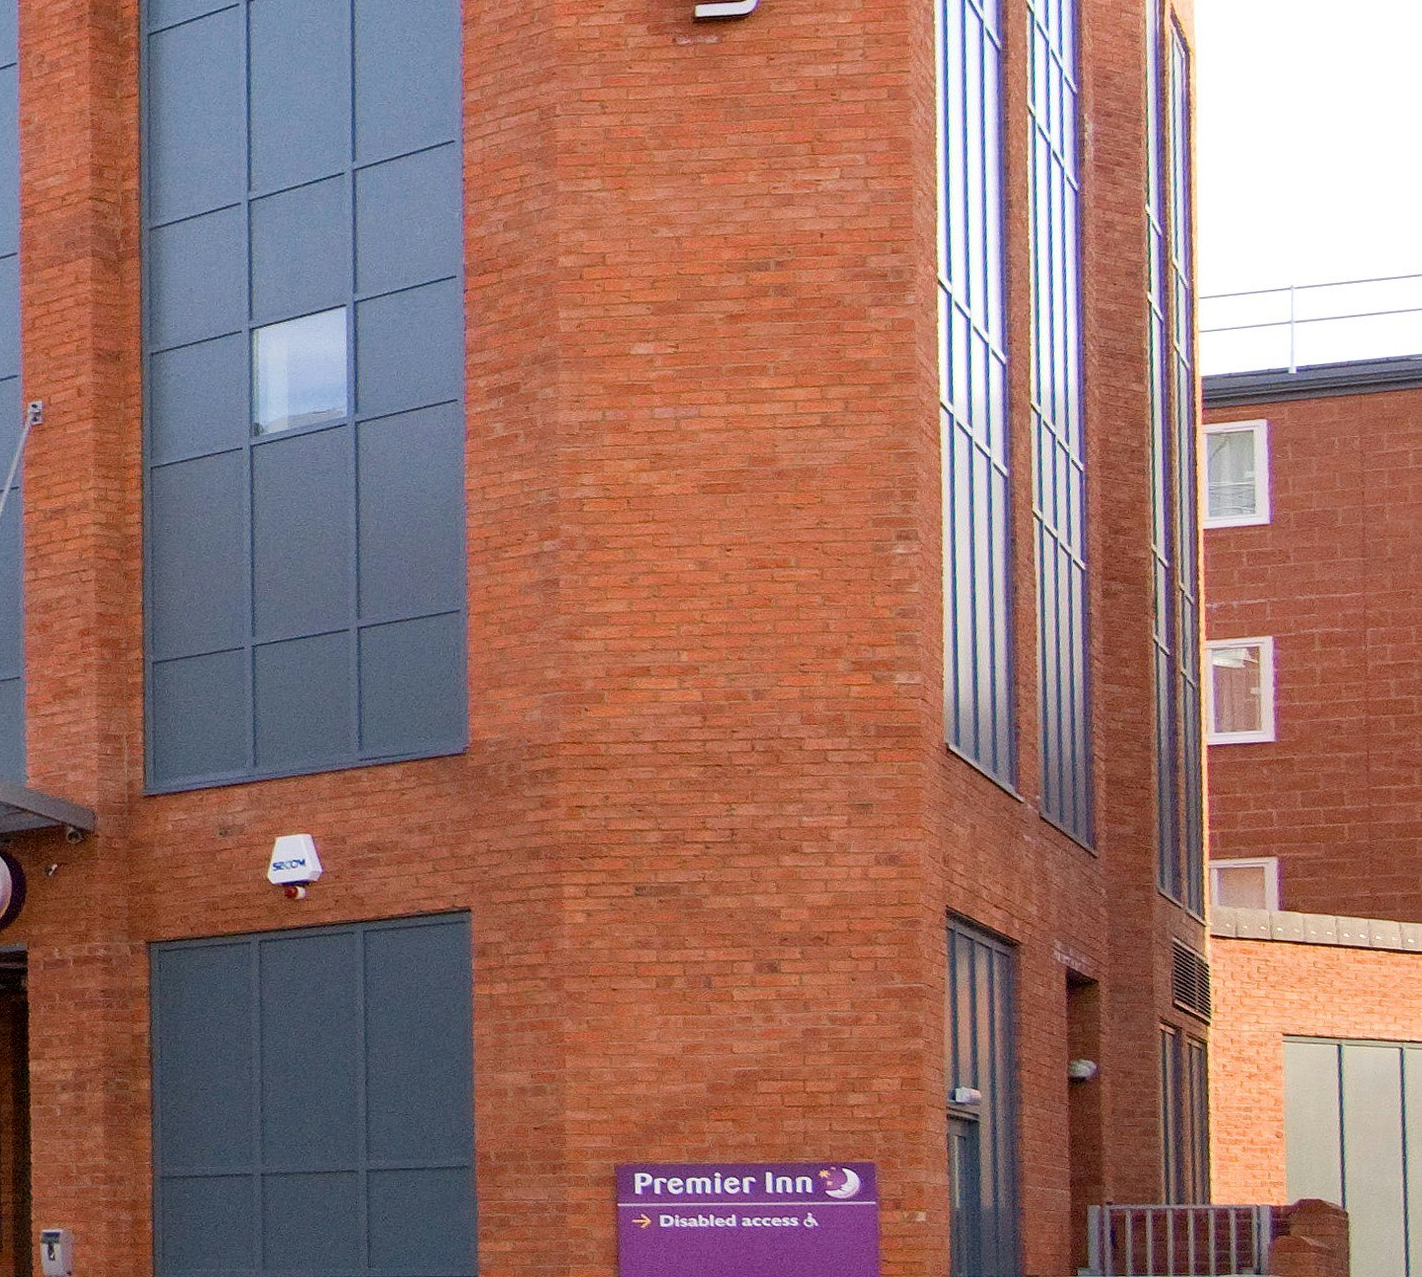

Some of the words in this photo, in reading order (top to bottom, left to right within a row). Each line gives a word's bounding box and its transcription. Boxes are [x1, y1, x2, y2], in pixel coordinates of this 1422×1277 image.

[633, 1172, 756, 1195] Premier
[765, 1171, 814, 1194] Inn
[659, 1213, 737, 1227] Disabled
[741, 1215, 799, 1227] access
